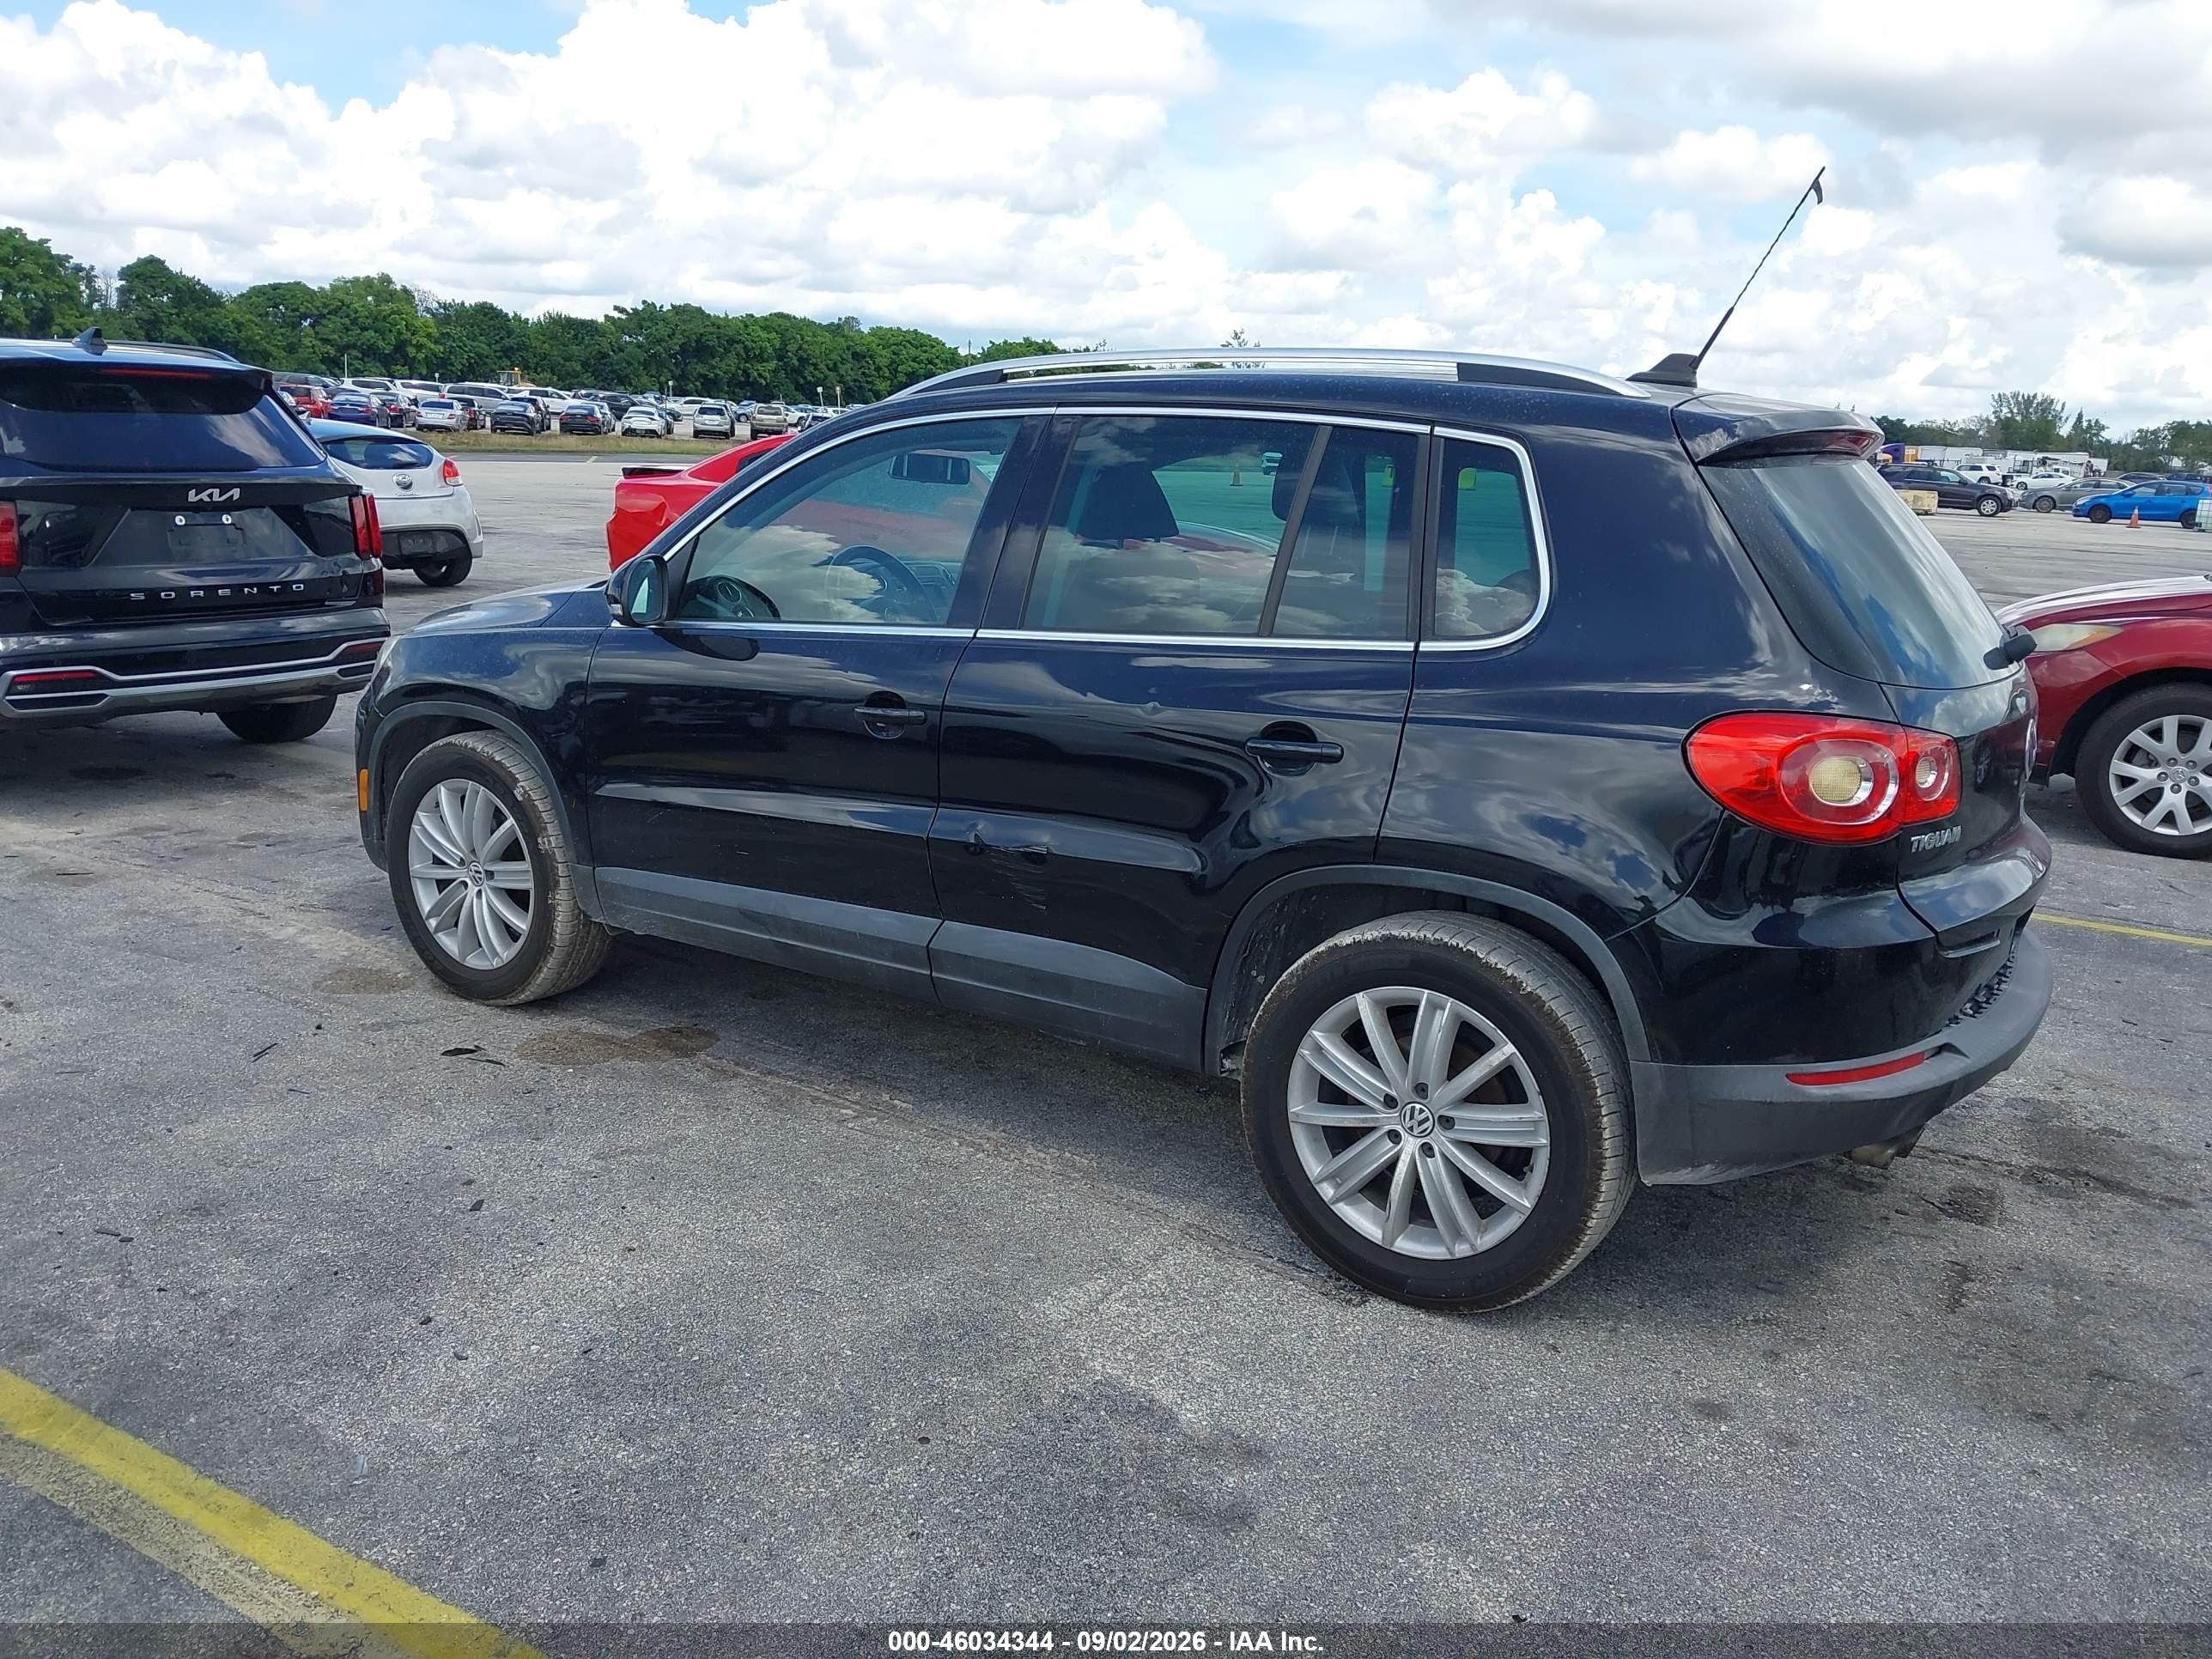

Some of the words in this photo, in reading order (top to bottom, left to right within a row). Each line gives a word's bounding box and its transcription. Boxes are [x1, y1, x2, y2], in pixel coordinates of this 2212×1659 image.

[187, 488, 241, 502] KIA
[130, 583, 305, 600] SORENTO
[1910, 825, 1962, 853] TIGUAN
